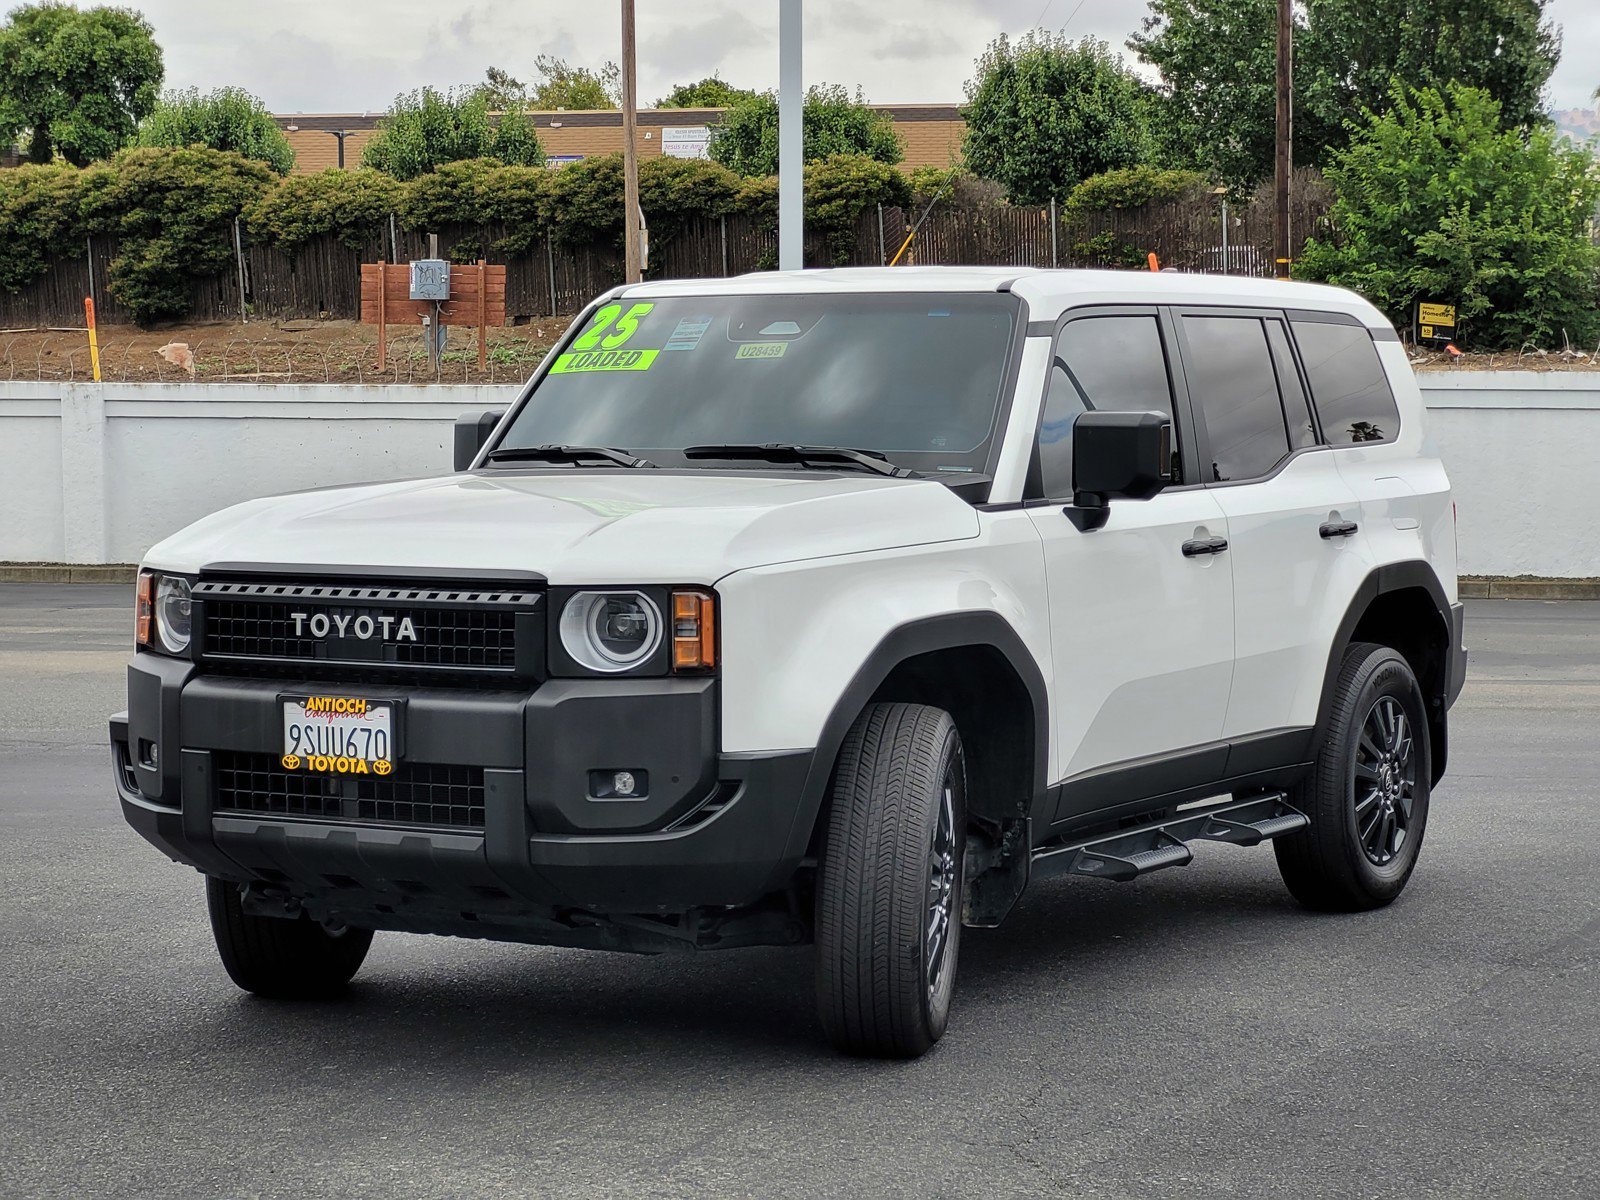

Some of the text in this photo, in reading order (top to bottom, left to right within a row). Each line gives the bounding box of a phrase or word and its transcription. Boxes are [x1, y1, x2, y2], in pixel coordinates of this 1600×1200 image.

[573, 303, 654, 350] 25
[564, 351, 643, 370] LOADED
[741, 345, 782, 357] U28459
[291, 613, 417, 641] TOYOTA
[306, 697, 367, 713] ANTIOCH
[289, 724, 387, 760] 9SUU670
[306, 755, 369, 774] TOYOTA
